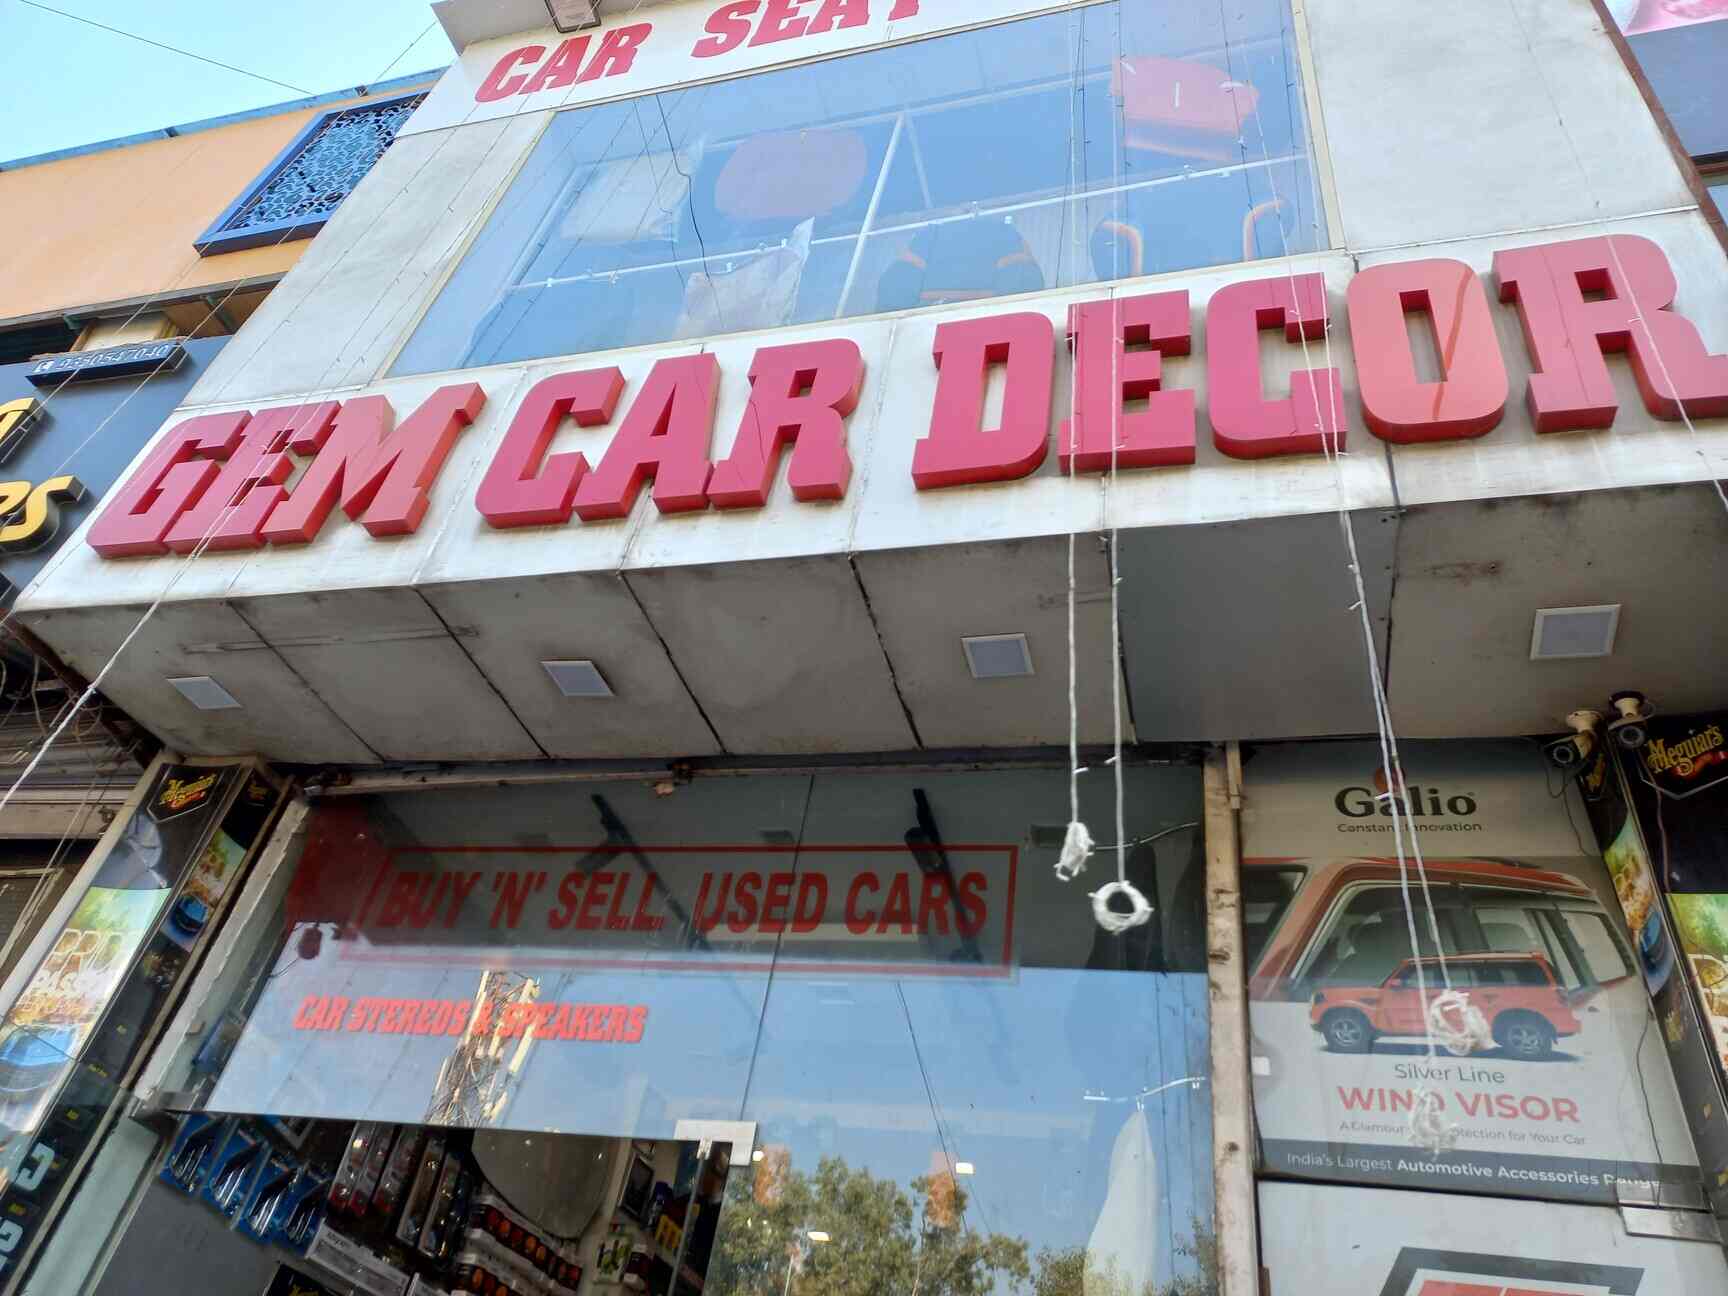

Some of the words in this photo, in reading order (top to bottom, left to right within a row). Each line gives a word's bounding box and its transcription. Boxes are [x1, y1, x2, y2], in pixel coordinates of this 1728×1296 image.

[475, 22, 653, 102] CAR
[86, 382, 487, 559] GEM
[475, 338, 864, 529] CAR
[912, 233, 1728, 490] DECOR
[1335, 786, 1477, 818] Galio
[1337, 823, 1400, 833] Constan
[375, 870, 481, 929] BUY
[549, 870, 669, 932] SELL
[692, 870, 828, 933] USED
[843, 870, 988, 937] CARS
[294, 994, 348, 1030] CAR
[348, 996, 471, 1037] STEREOS
[471, 1000, 495, 1036] &
[497, 1001, 649, 1043] SPEAKERS
[1394, 1063, 1452, 1082] Silver
[1459, 1066, 1505, 1084] Line
[1455, 1090, 1581, 1123] VISOR
[1508, 1129, 1527, 1142] for
[1529, 1131, 1560, 1144] Your
[1288, 1152, 1332, 1167] India's
[1337, 1156, 1393, 1172] Largest
[1397, 1159, 1493, 1177] Automotive
[1498, 1165, 1600, 1185] Accessories
